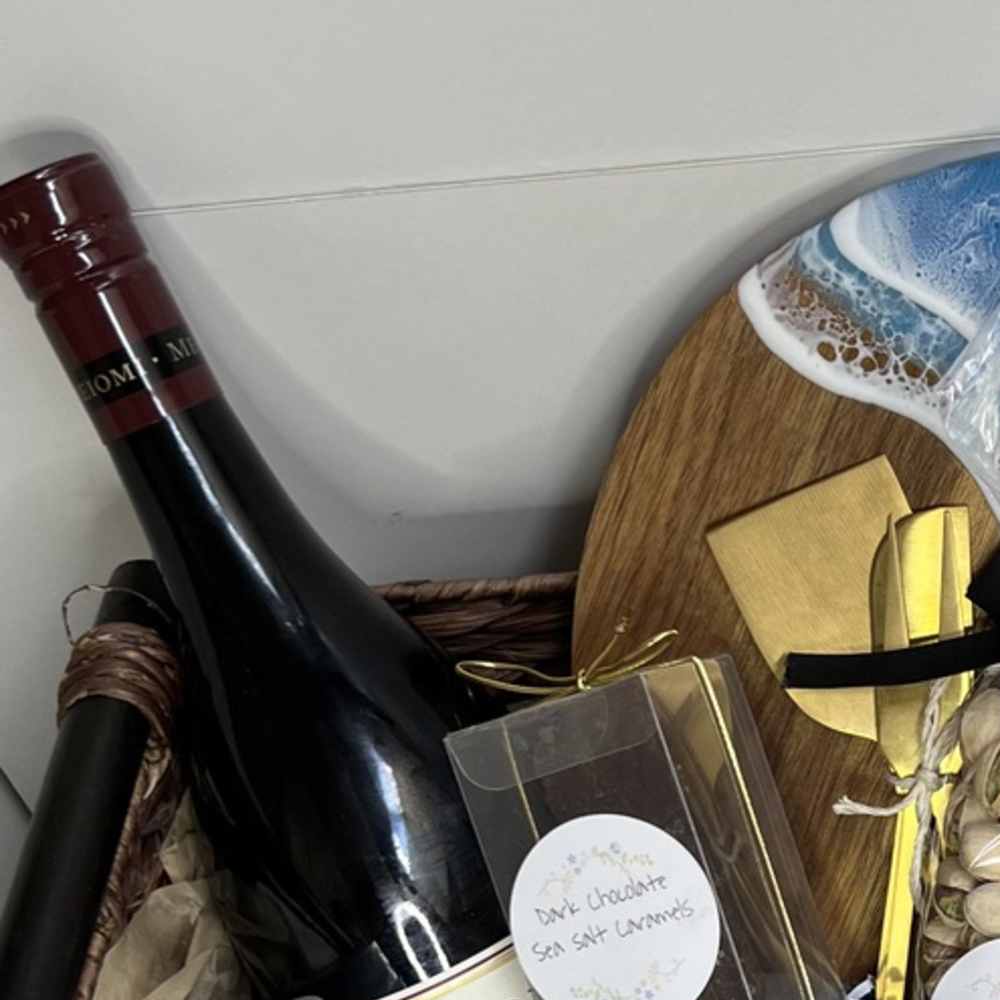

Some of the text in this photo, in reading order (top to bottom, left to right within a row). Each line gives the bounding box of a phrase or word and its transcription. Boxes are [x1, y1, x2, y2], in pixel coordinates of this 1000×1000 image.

[531, 898, 696, 963] Sea Salt Caramels
[533, 873, 668, 928] Dark Chocolate
